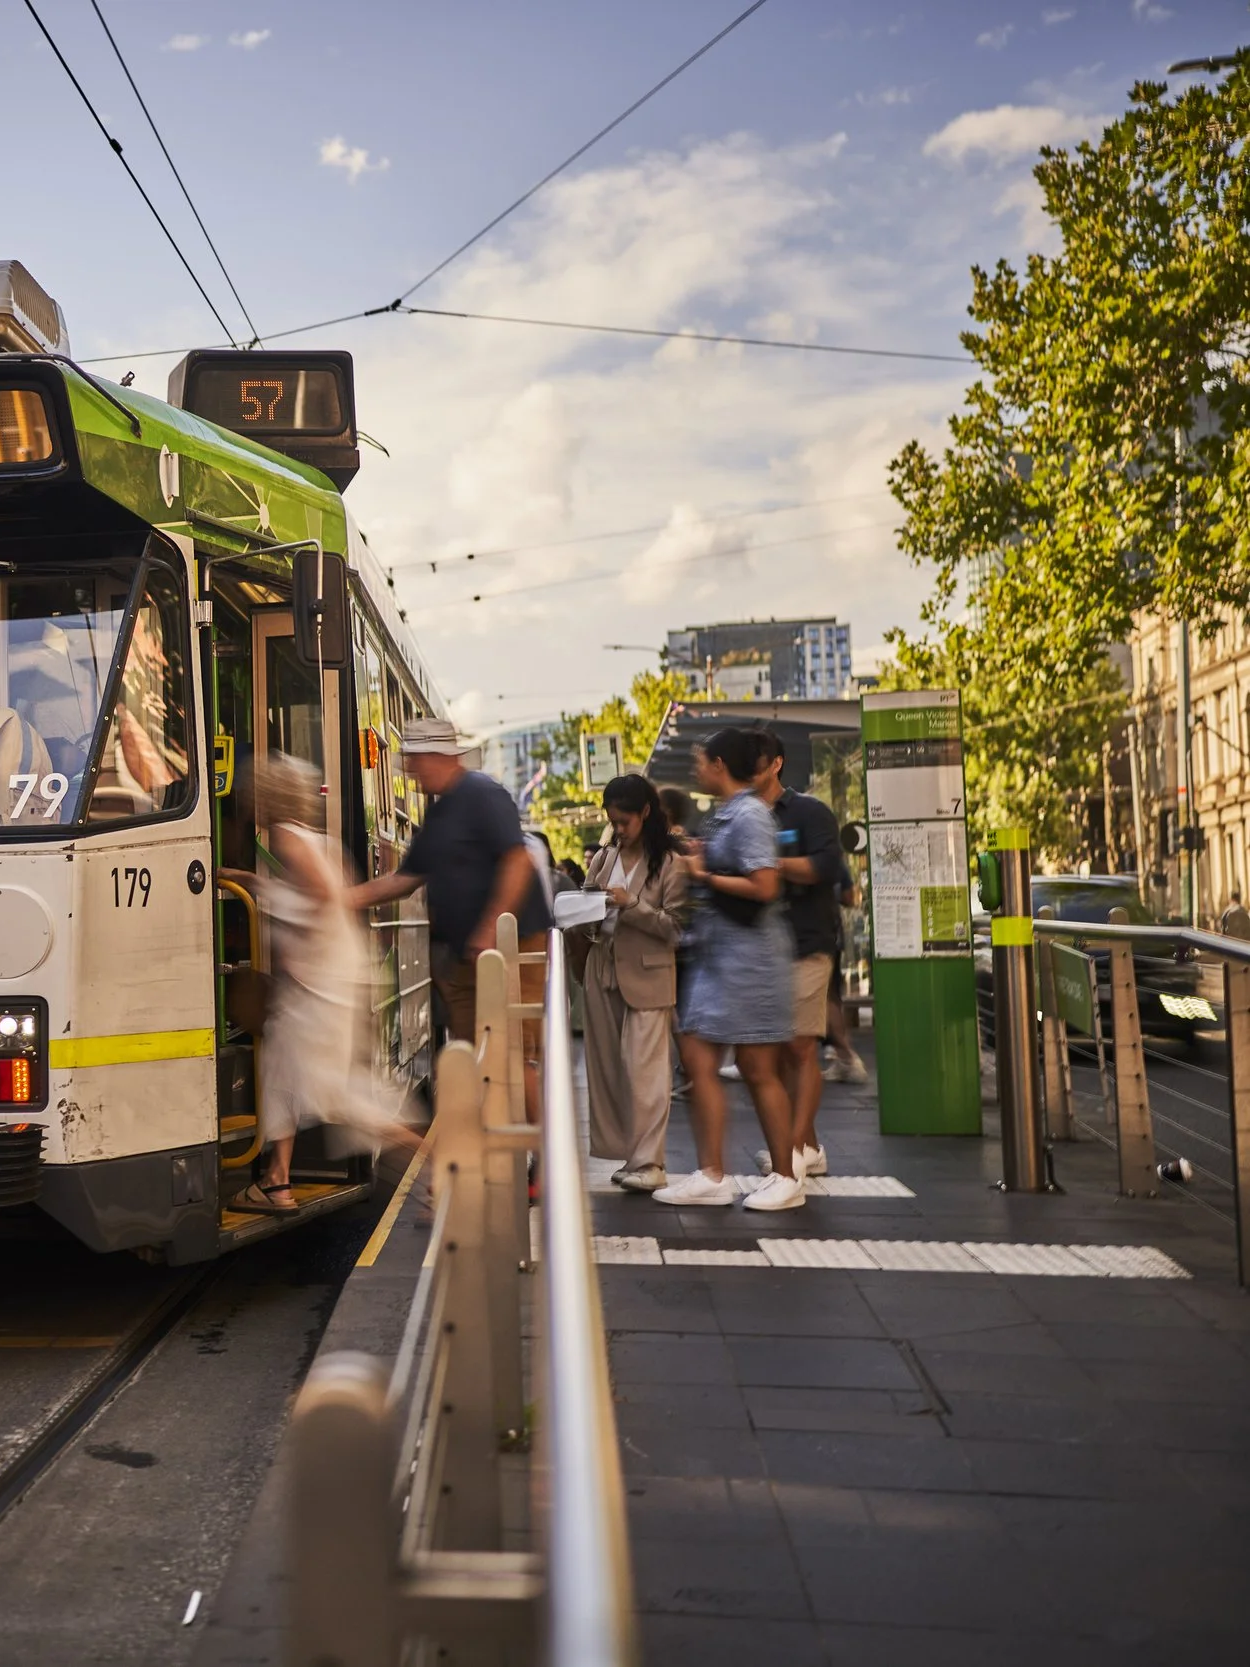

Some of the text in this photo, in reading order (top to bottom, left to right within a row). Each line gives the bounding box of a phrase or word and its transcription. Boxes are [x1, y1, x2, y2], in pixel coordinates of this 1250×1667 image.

[241, 381, 284, 420] 57
[895, 709, 957, 722] Queen Victoria
[929, 719, 957, 729] Market
[951, 798, 961, 815] 7
[111, 867, 152, 908] 179
